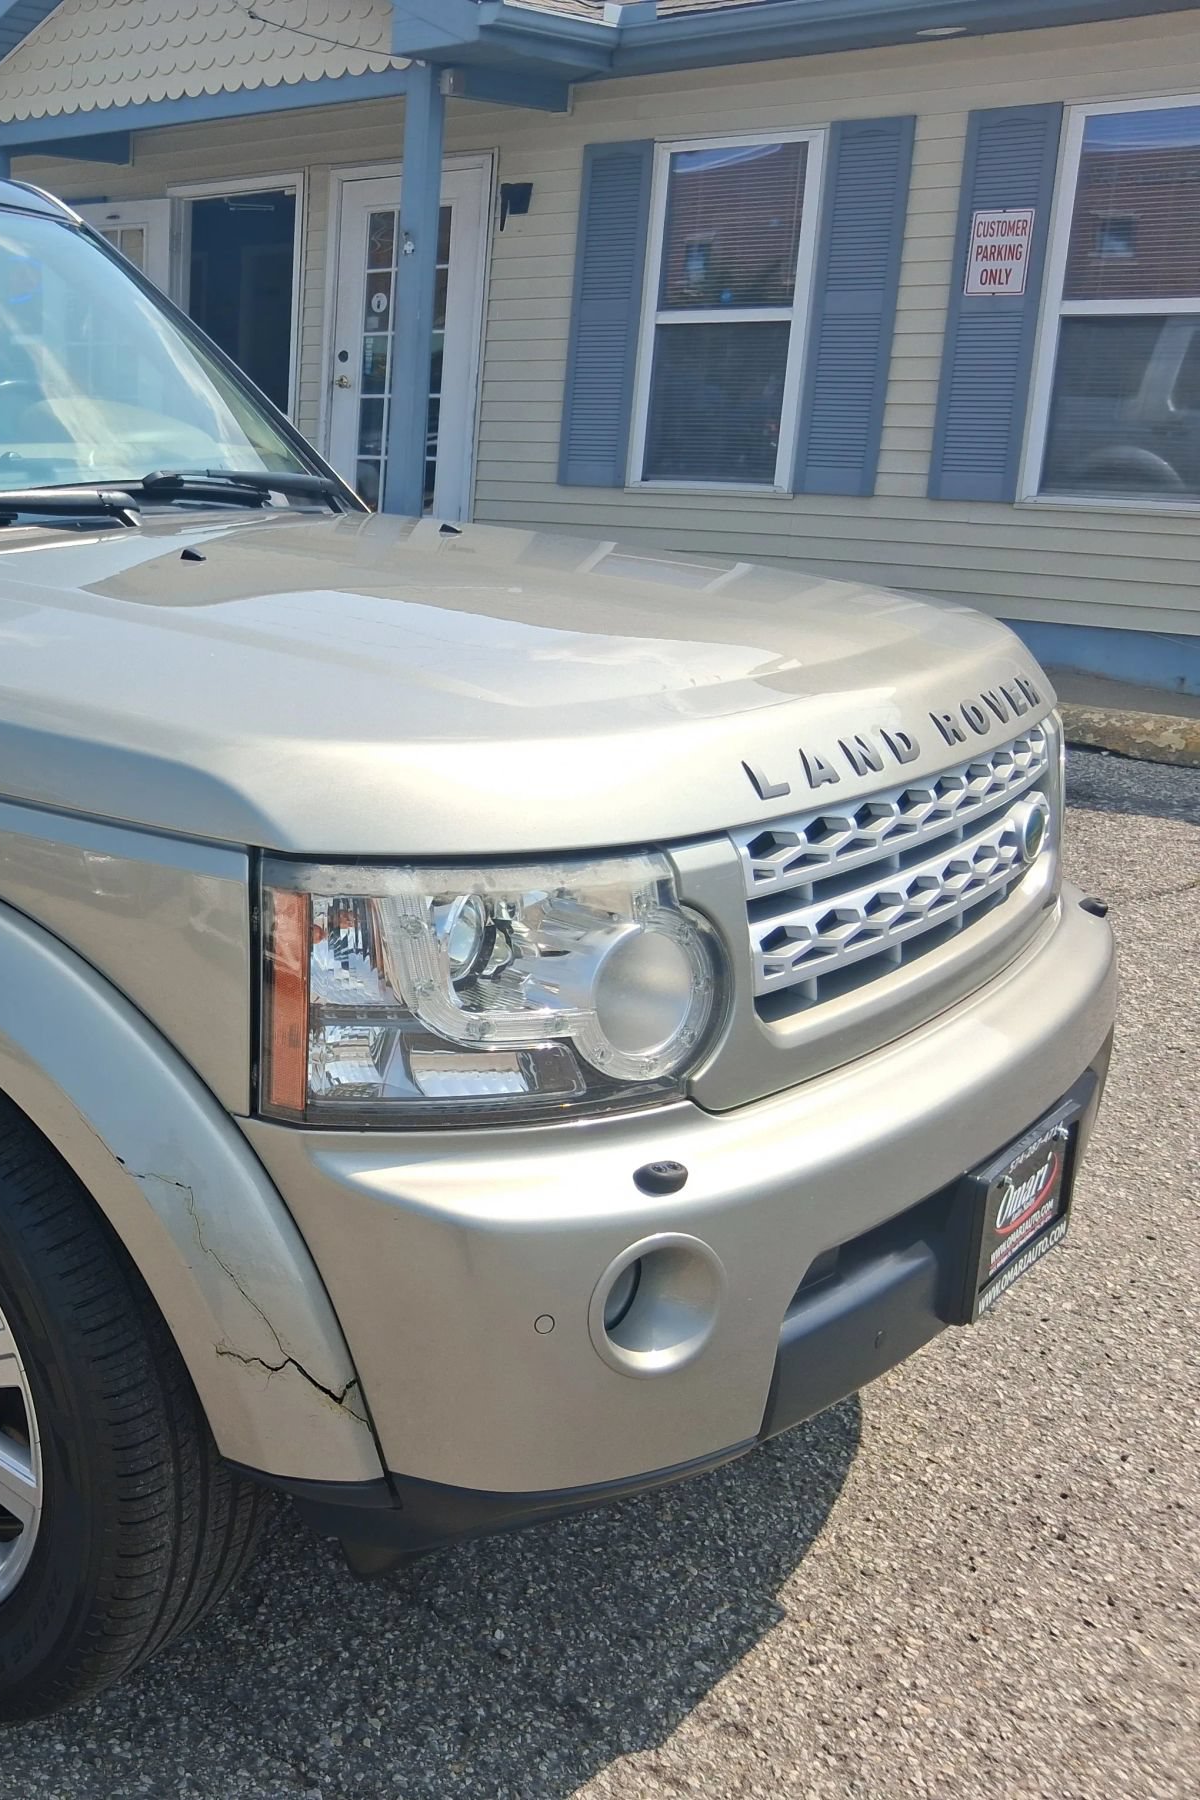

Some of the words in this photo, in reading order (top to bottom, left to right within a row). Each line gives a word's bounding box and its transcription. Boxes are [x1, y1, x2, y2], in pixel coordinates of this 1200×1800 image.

[975, 244, 1023, 262] PARKING
[976, 219, 1028, 238] CUSTOMER
[979, 268, 1012, 286] ONLY
[741, 728, 921, 801] LAND
[928, 677, 1041, 746] ROVER
[996, 1151, 1053, 1229] Omari
[990, 1199, 1055, 1264] WWW.OMARIAUTO.COM
[978, 1221, 1067, 1315] WWW.OMARIAUTO.COM
